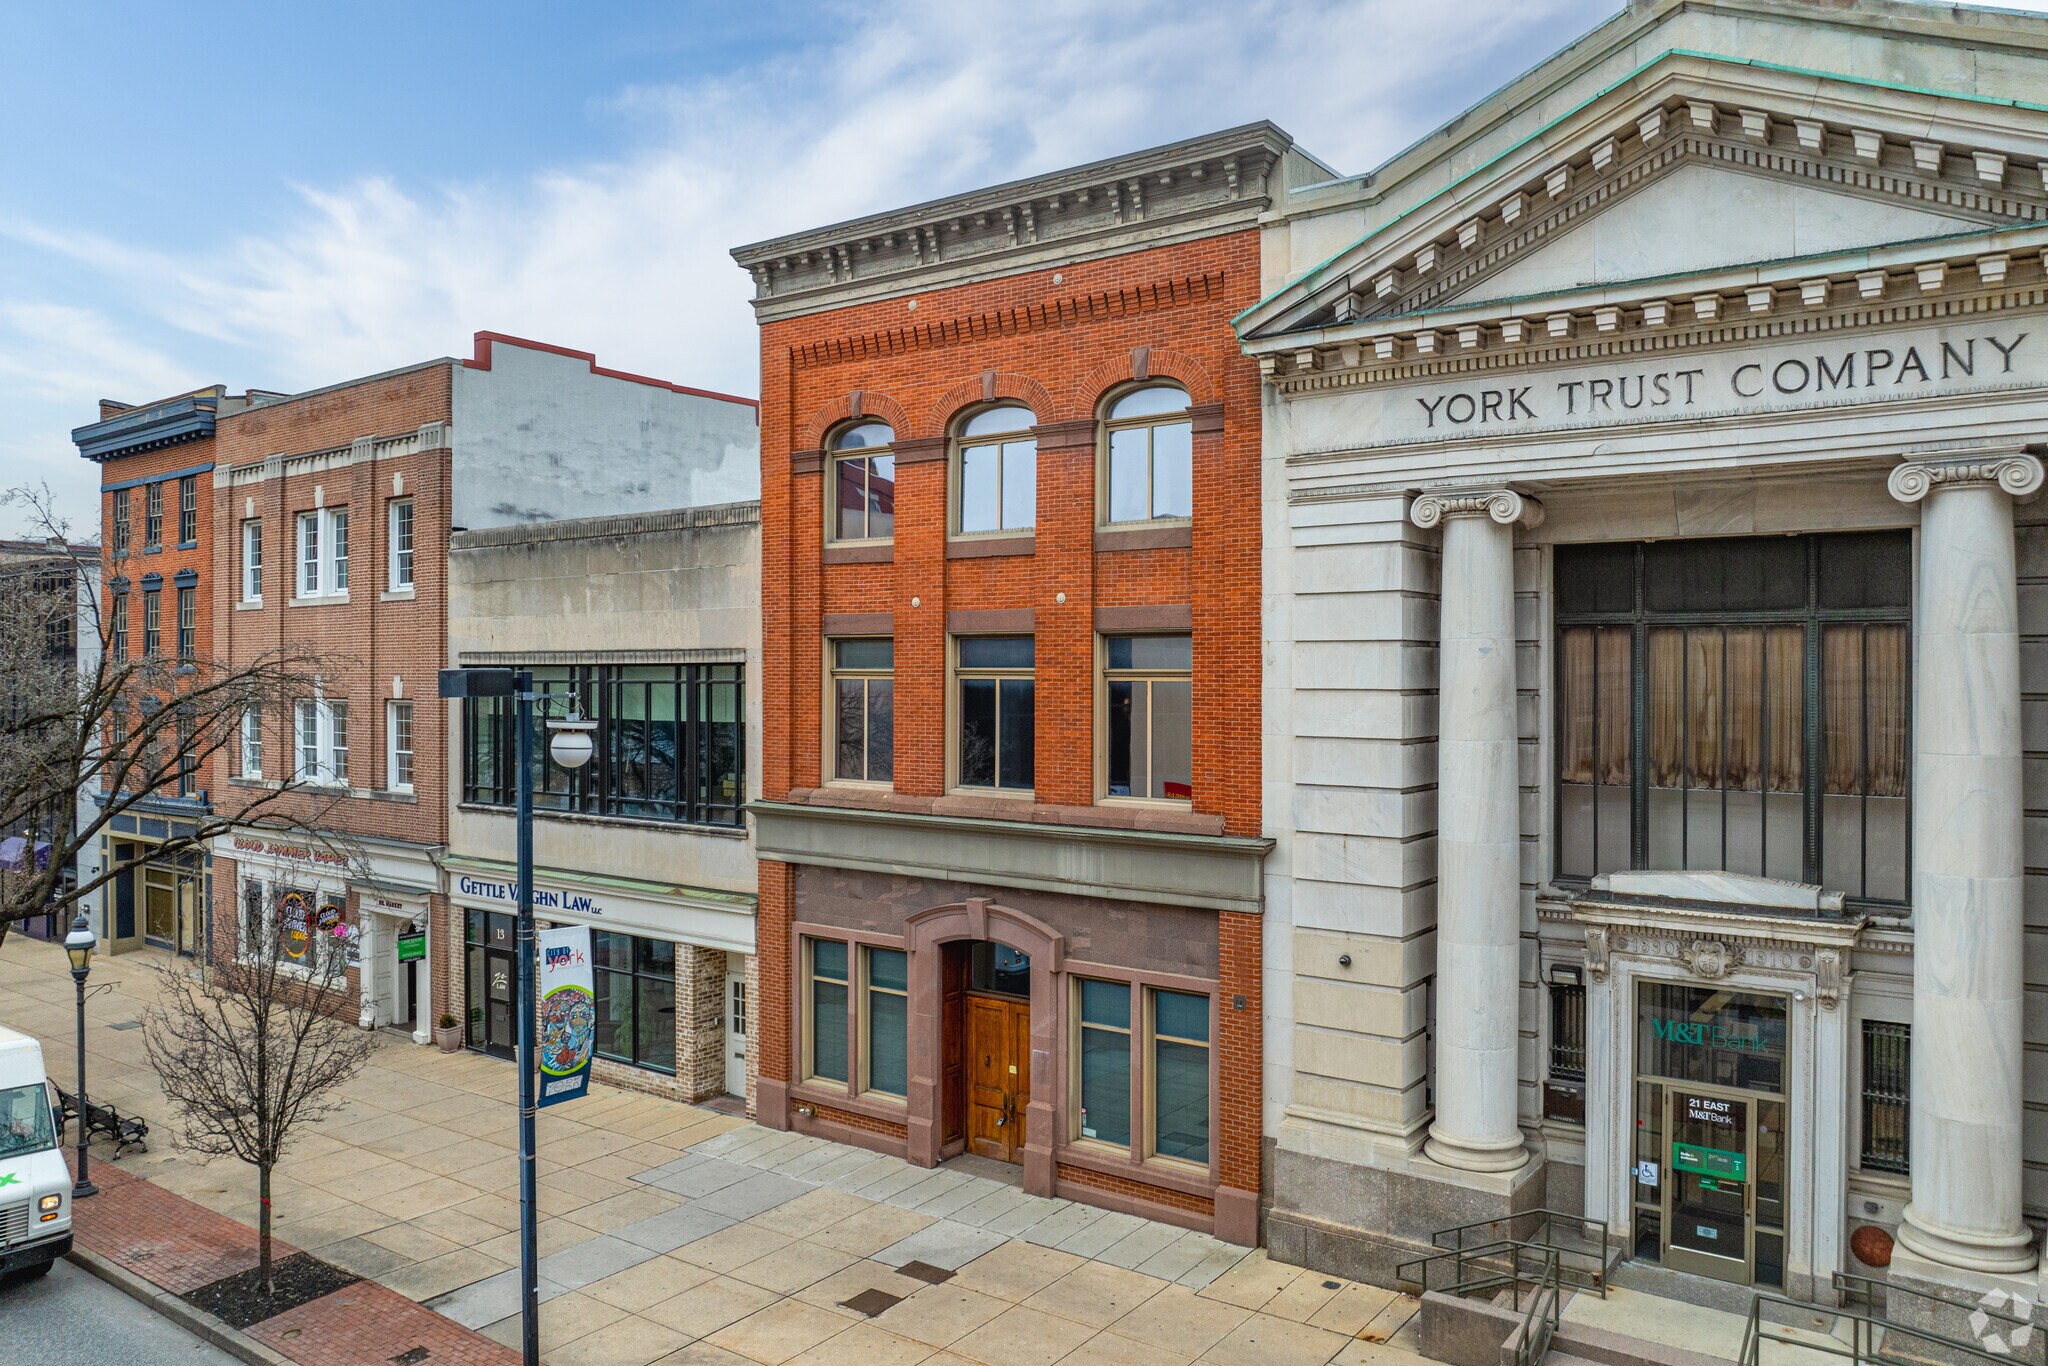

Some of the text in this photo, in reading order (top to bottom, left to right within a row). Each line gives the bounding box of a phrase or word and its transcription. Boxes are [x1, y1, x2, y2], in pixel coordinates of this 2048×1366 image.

[1415, 332, 2031, 428] YORK TRUST COMPANY
[234, 837, 264, 852] CLOUD
[265, 842, 312, 860] JAMMER
[460, 876, 506, 899] GETTLE
[507, 883, 558, 907] VGHN
[562, 890, 592, 913] LAW
[496, 928, 505, 940] 13
[1632, 937, 1675, 955] 1890
[1748, 949, 1792, 969] 1910
[1652, 1017, 1769, 1054] M&T Bank
[1689, 1098, 1731, 1112] 21 EAST
[1689, 1109, 1733, 1125] M&T Bank
